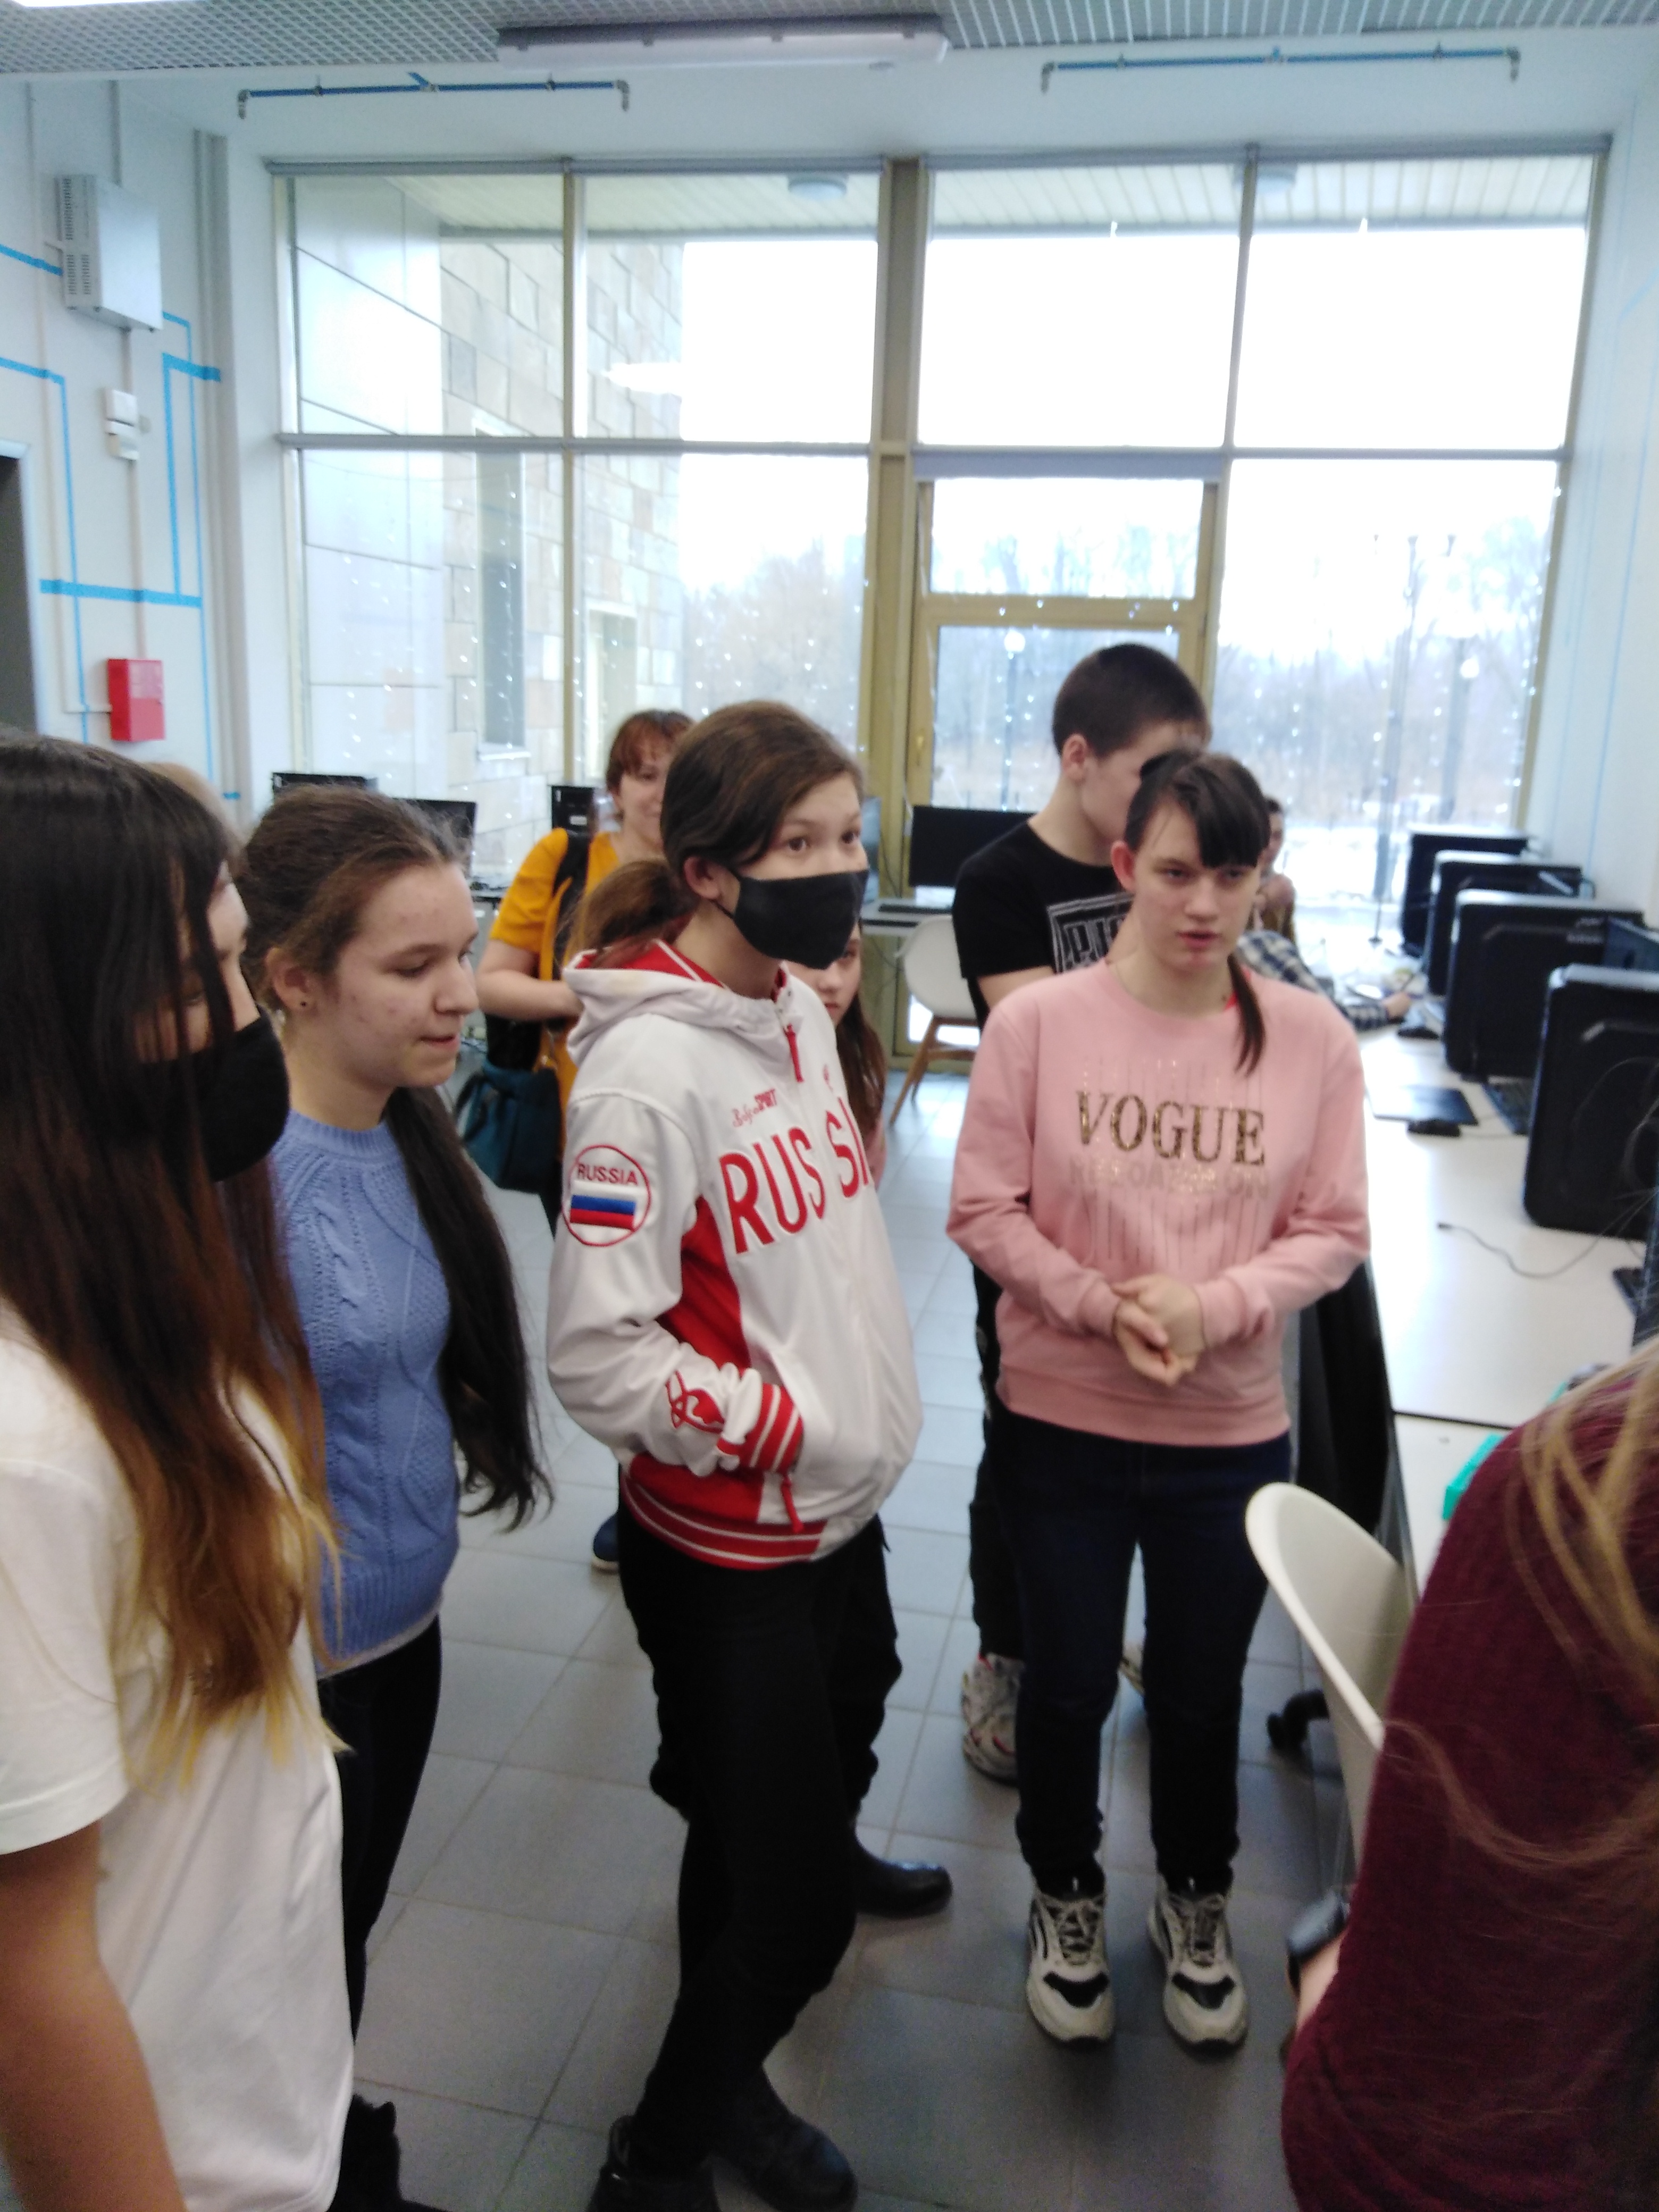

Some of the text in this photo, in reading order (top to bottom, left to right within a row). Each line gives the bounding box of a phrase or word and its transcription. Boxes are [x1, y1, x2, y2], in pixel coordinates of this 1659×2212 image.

[1076, 1090, 1266, 1167] VOGUE
[577, 1163, 639, 1186] RUSSIA
[719, 1097, 869, 1254] RUSSI
